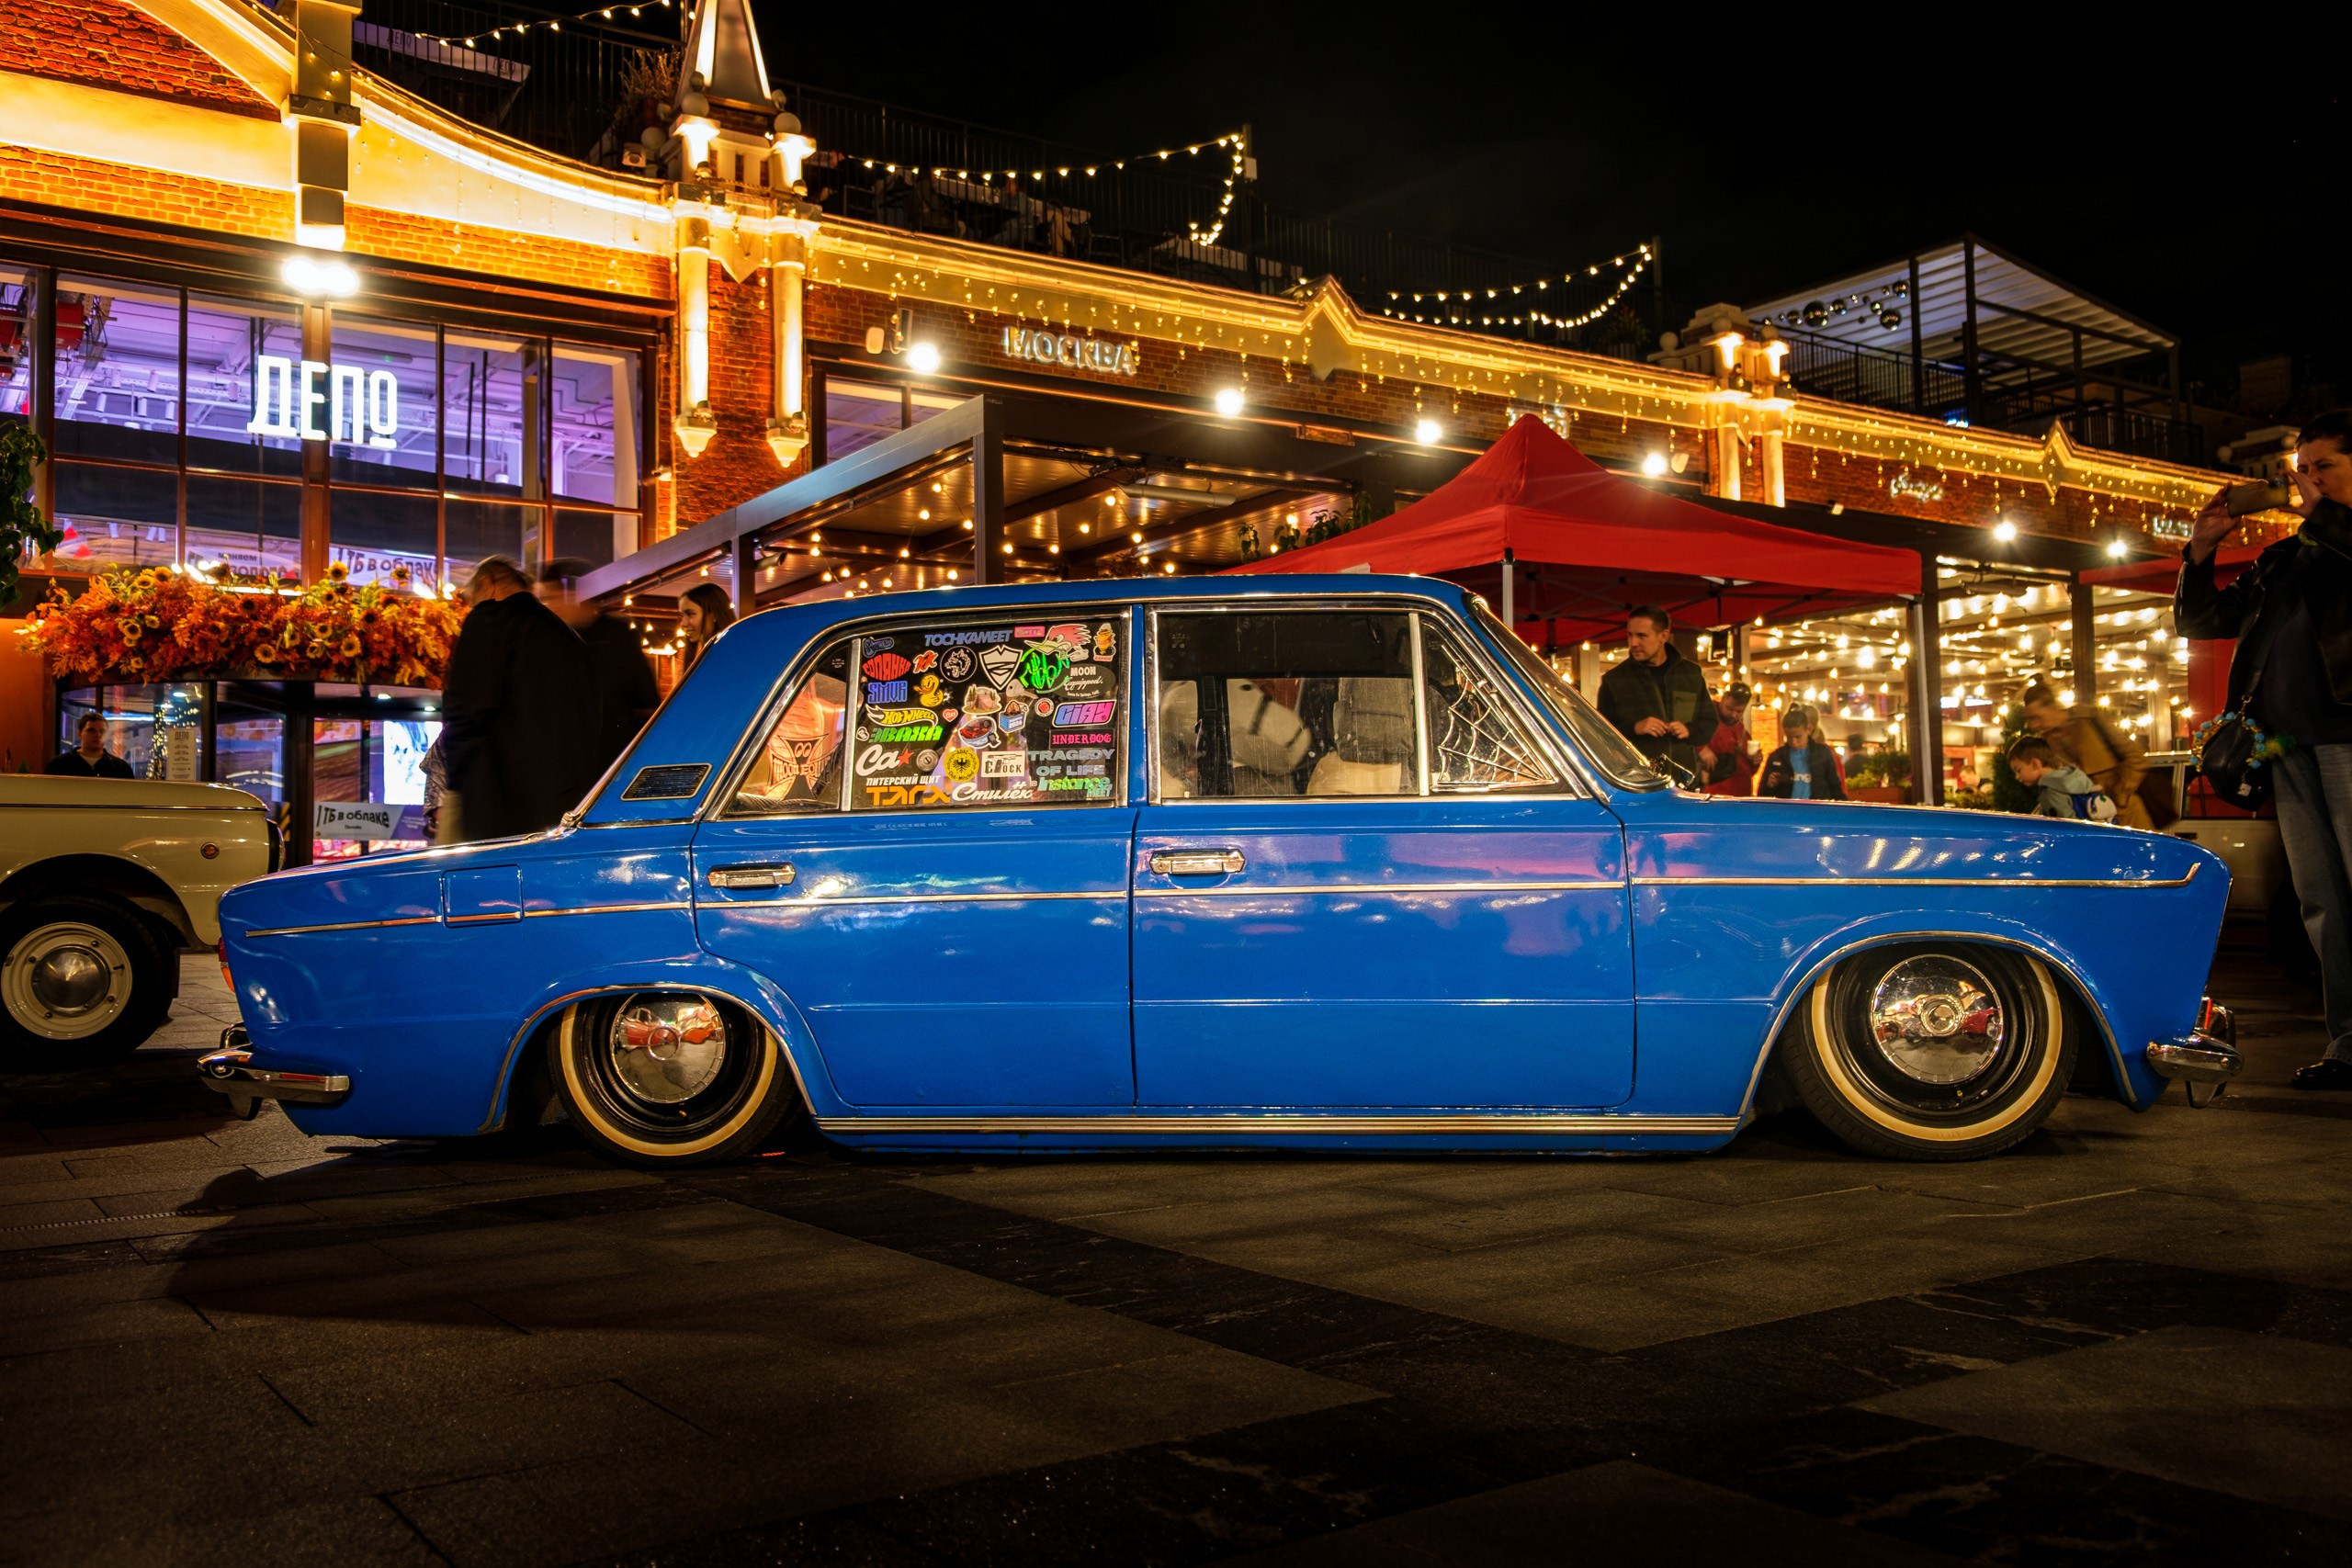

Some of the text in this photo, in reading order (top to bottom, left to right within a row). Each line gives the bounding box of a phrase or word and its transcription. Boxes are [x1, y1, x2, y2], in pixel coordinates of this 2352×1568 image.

[1004, 326, 1137, 375] МОСКВА
[247, 355, 398, 449] ДЕПО
[924, 629, 1012, 647] TOCHKAMEET
[1069, 665, 1097, 677] MOON
[1052, 733, 1112, 745] UNDERDOG
[1026, 749, 1115, 761] TRAGEDY
[1036, 764, 1105, 777] OF LIFE
[866, 773, 942, 785] ПИТЕРСКИЙ ЩИТ
[323, 807, 336, 824] ТБ
[337, 811, 345, 821] в
[346, 809, 390, 828] облаке
